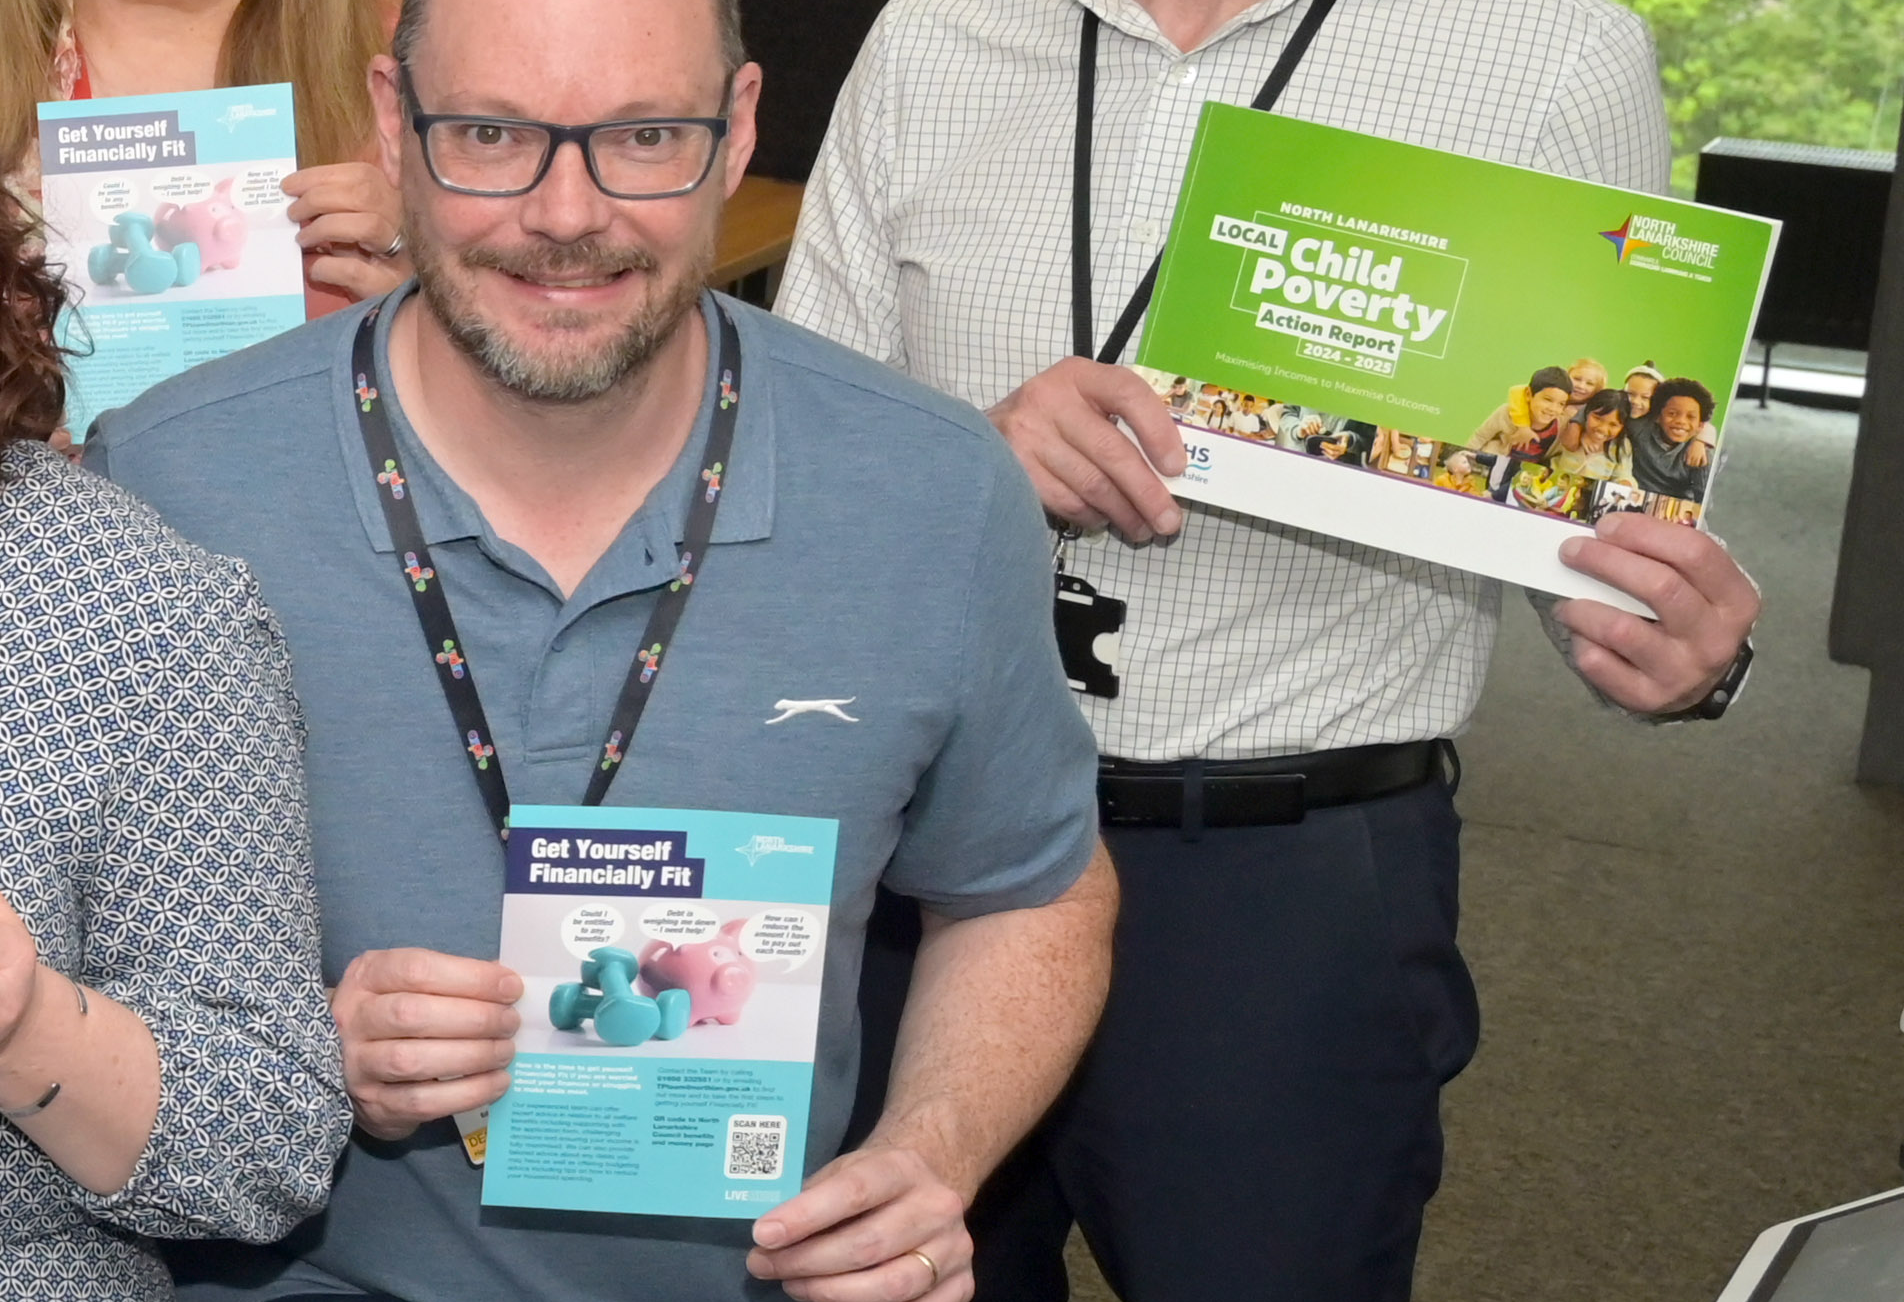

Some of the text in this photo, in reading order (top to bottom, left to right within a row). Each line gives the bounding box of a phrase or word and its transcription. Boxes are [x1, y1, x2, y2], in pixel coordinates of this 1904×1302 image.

[58, 120, 168, 144] Get Yourself
[59, 140, 186, 164] Financially Fit
[1216, 221, 1279, 249] LOCAL
[1280, 201, 1449, 250] NORTH LANARKSHIRE
[1632, 215, 1677, 234] NORTH
[1629, 227, 1720, 257] LANARKSHIRE
[1290, 237, 1403, 292] Child
[1662, 247, 1716, 269] COUNCIL
[1249, 257, 1447, 342] Poverty
[1260, 309, 1396, 354] Action Report
[1303, 343, 1393, 374] 2024 2025
[1215, 351, 1441, 416] Maximising Incomes to Maximise Outcomes
[531, 838, 672, 862] Get Yourself
[529, 863, 692, 889] Financially Fit
